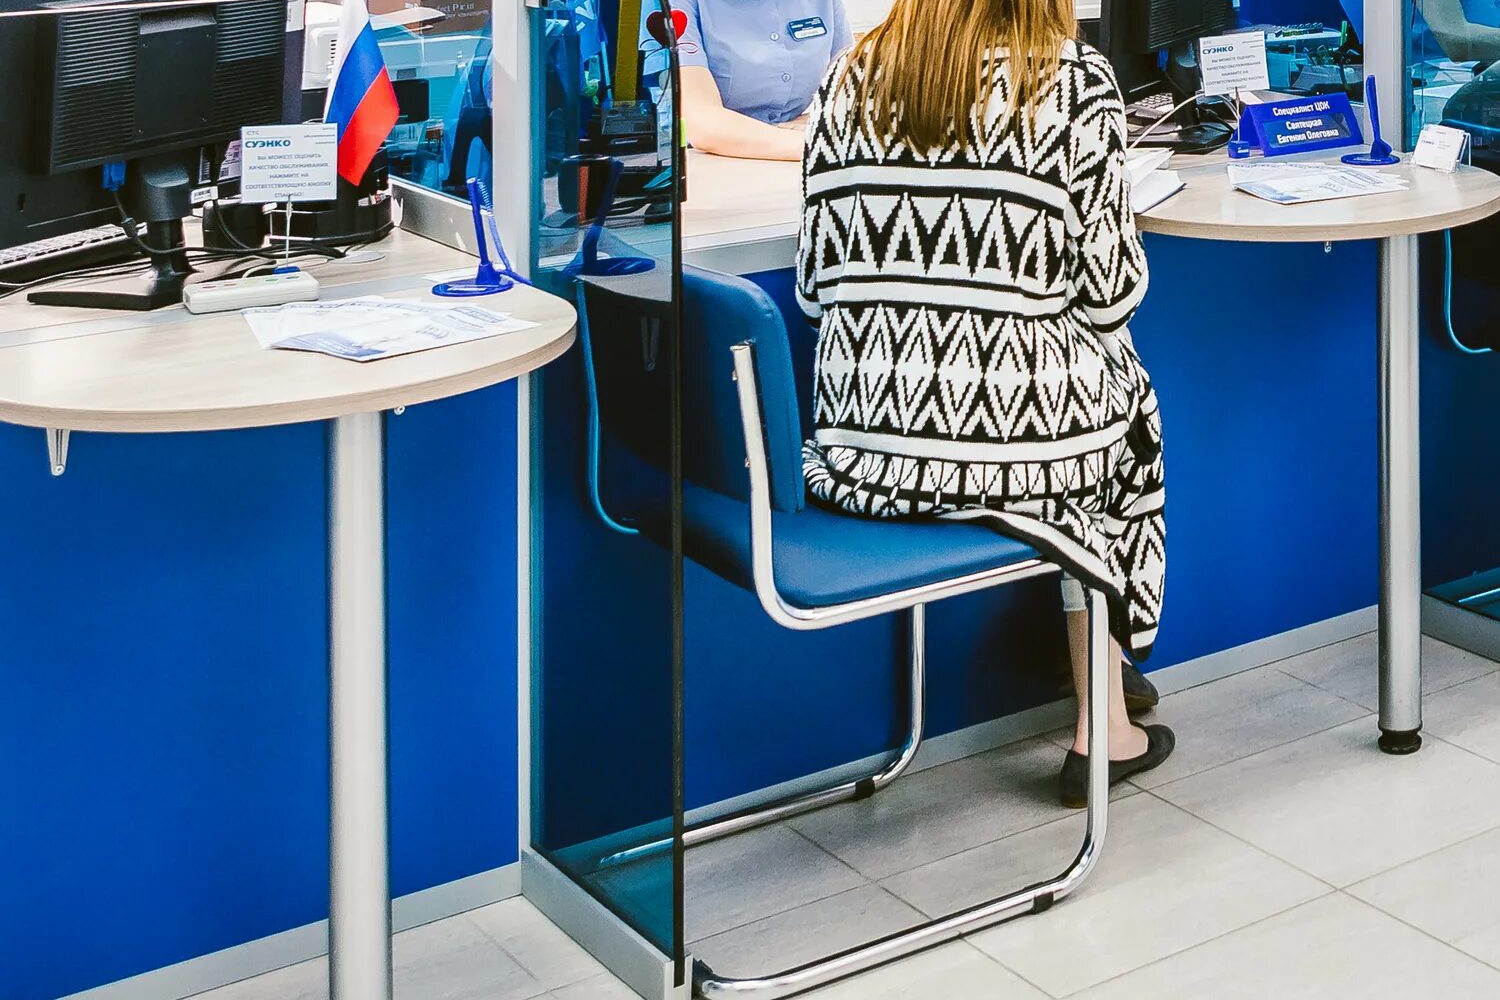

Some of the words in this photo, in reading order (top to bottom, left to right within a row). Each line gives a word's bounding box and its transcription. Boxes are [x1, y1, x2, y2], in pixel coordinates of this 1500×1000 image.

[1202, 45, 1234, 55] СУЭНКО
[1272, 103, 1314, 117] Специалист
[1313, 100, 1331, 112] ЦОК
[1285, 118, 1323, 130] Святецкая
[1276, 133, 1307, 144] Евгения
[1306, 128, 1340, 140] Олеговна
[244, 139, 291, 149] СУЭНКО
